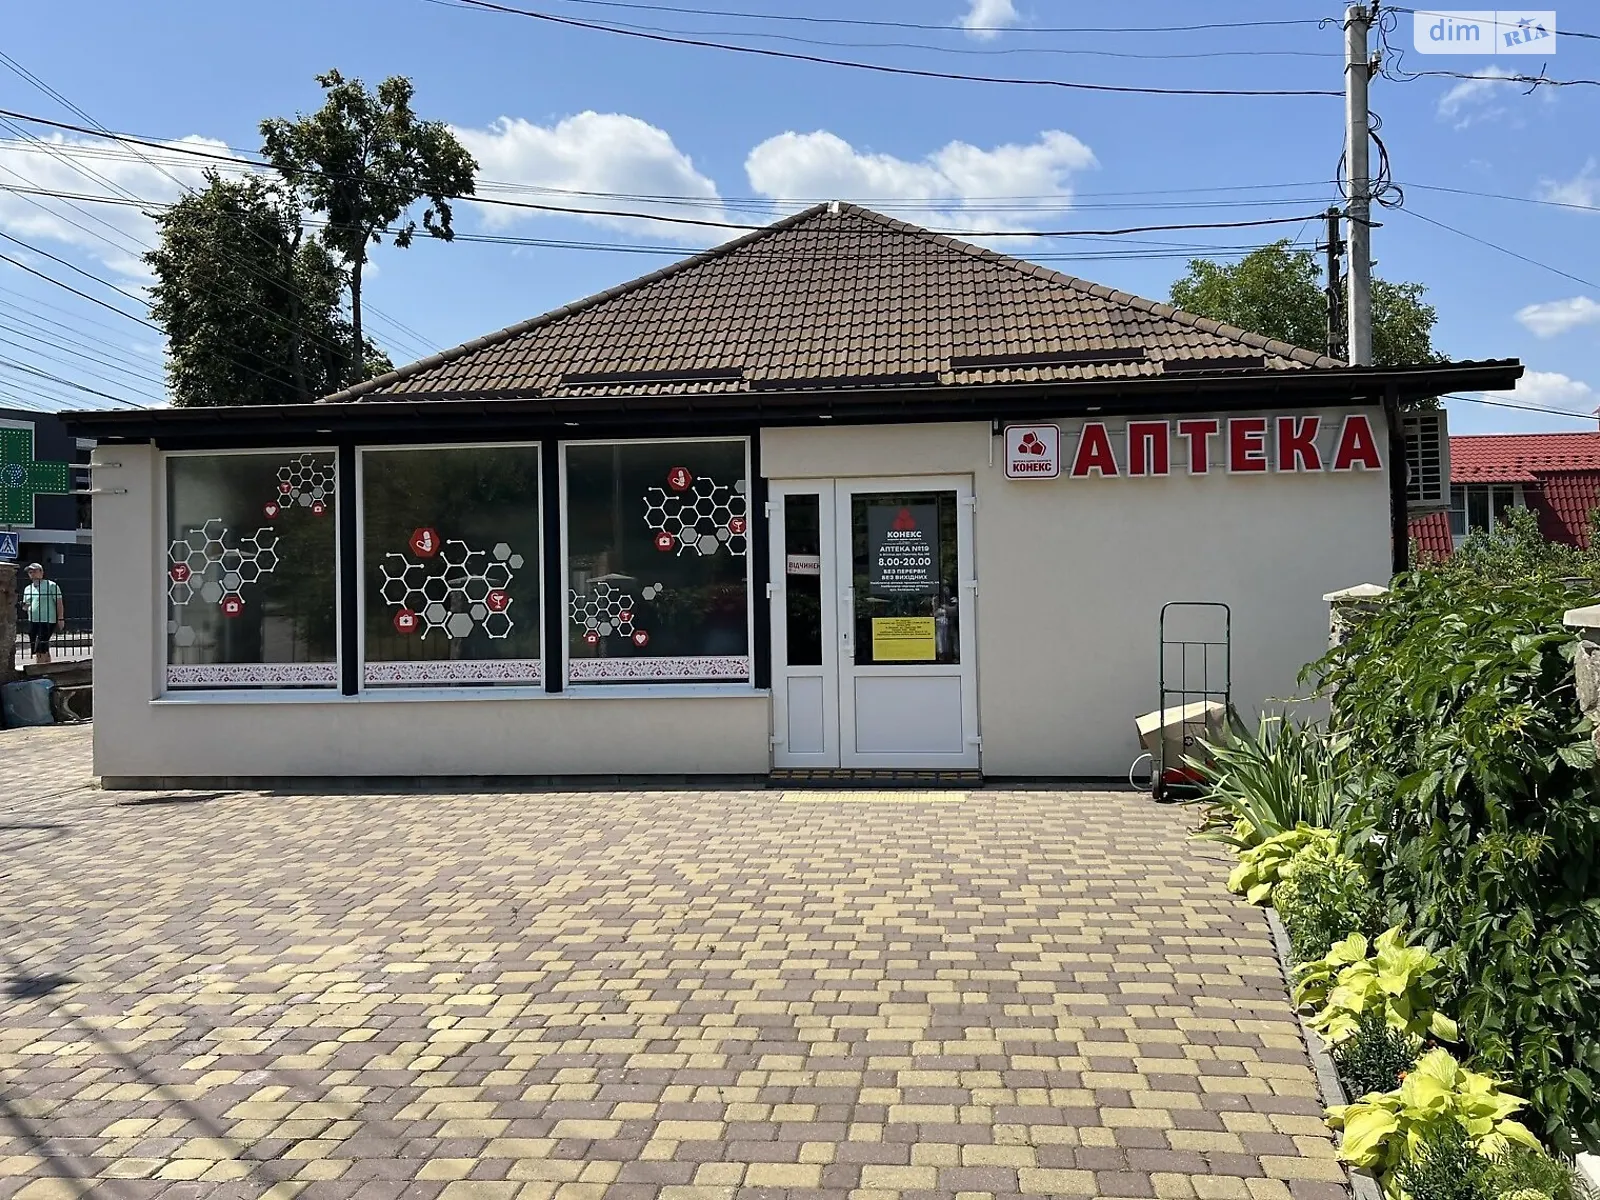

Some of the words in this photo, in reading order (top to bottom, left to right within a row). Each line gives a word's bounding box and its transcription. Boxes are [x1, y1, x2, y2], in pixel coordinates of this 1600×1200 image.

[1069, 414, 1382, 478] АПТЕКА
[1012, 462, 1052, 472] КОНЕКС
[878, 557, 931, 566] 8.00-20.00
